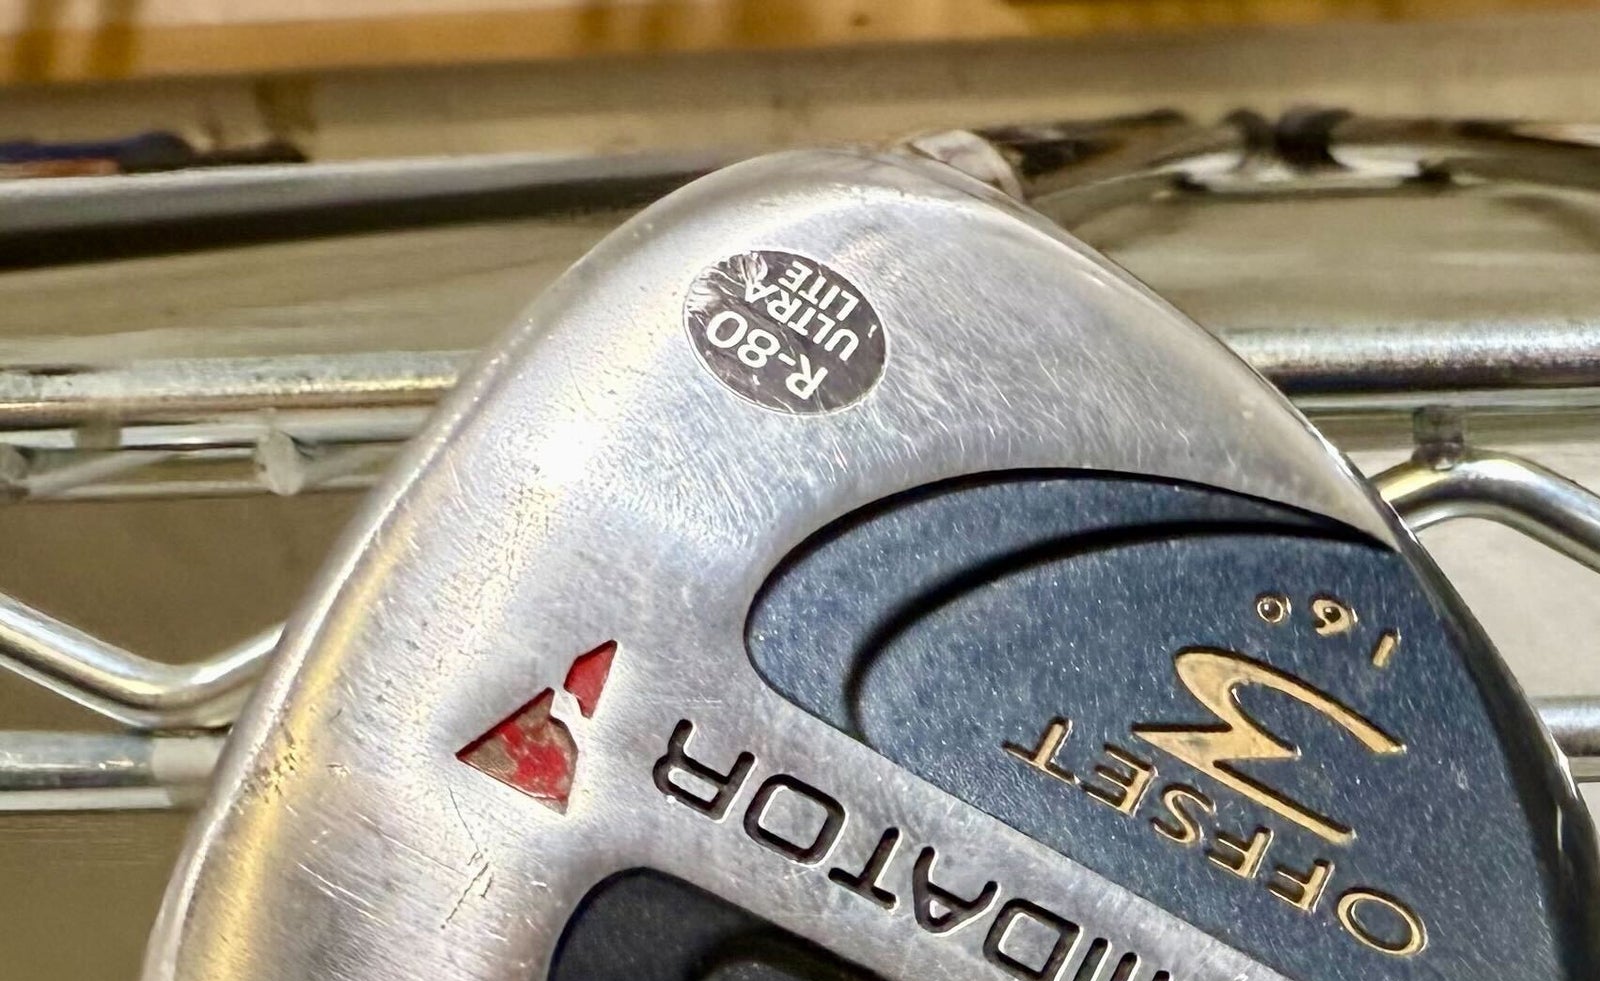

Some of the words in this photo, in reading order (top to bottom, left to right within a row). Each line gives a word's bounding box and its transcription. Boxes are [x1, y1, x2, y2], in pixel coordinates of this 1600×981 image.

[744, 283, 860, 361] ULTRA
[778, 260, 860, 320] LITE
[706, 310, 828, 400] R-80
[1001, 715, 1429, 957] OFFSET
